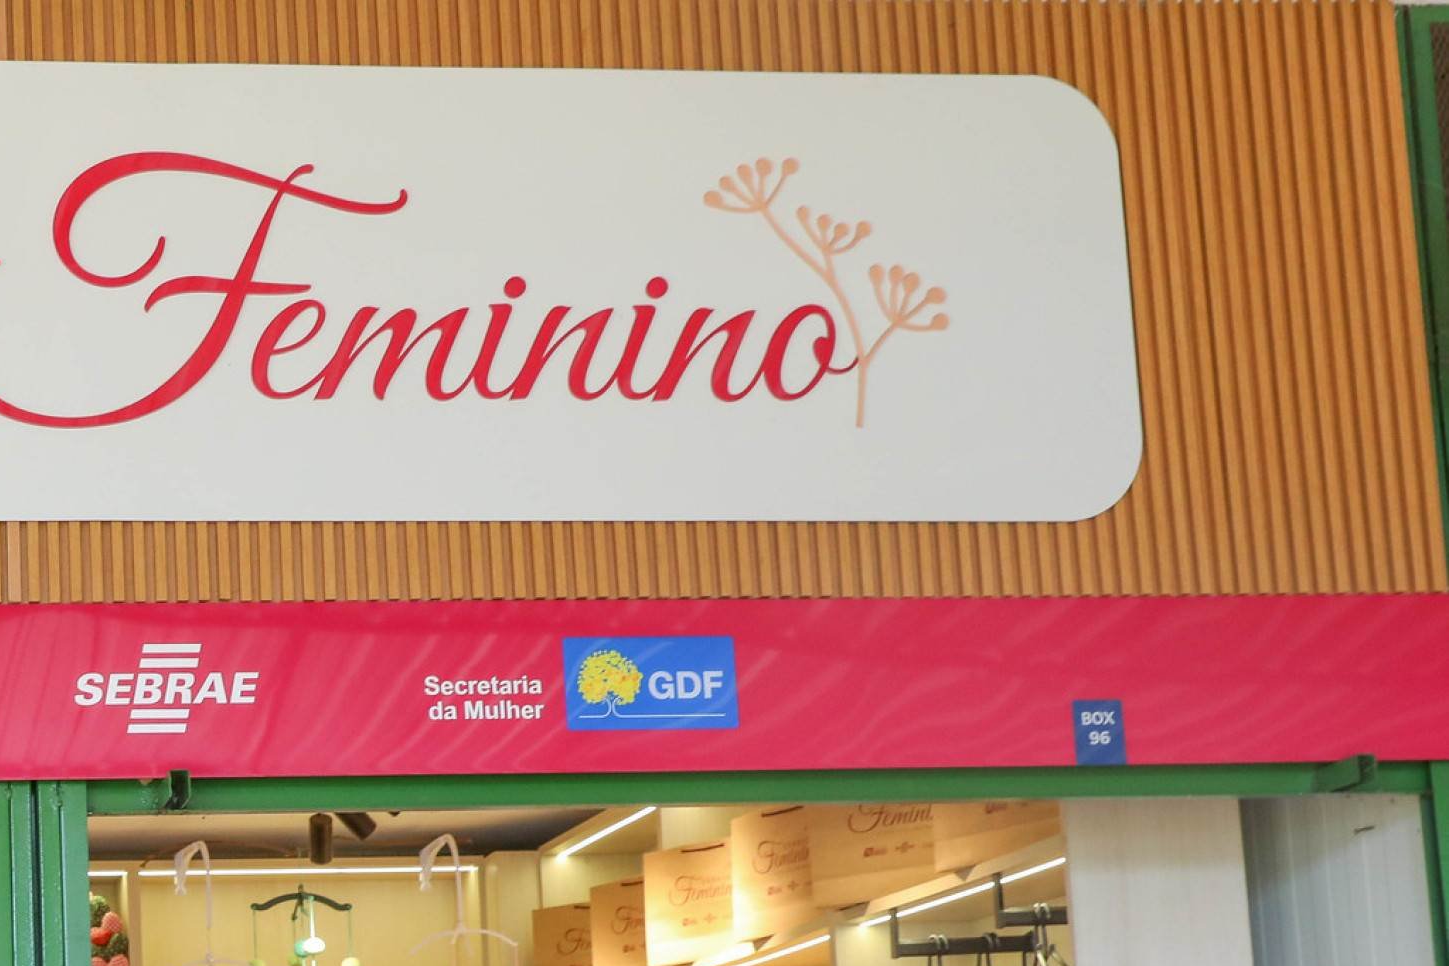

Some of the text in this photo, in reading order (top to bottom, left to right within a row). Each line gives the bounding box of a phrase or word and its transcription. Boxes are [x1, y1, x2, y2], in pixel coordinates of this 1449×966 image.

[73, 670, 260, 706] SEBRAE
[424, 674, 543, 696] Secretaria
[647, 670, 724, 701] GDF
[427, 698, 545, 721] da Mulher
[1080, 710, 1116, 727] BOX
[1087, 729, 1112, 746] 96
